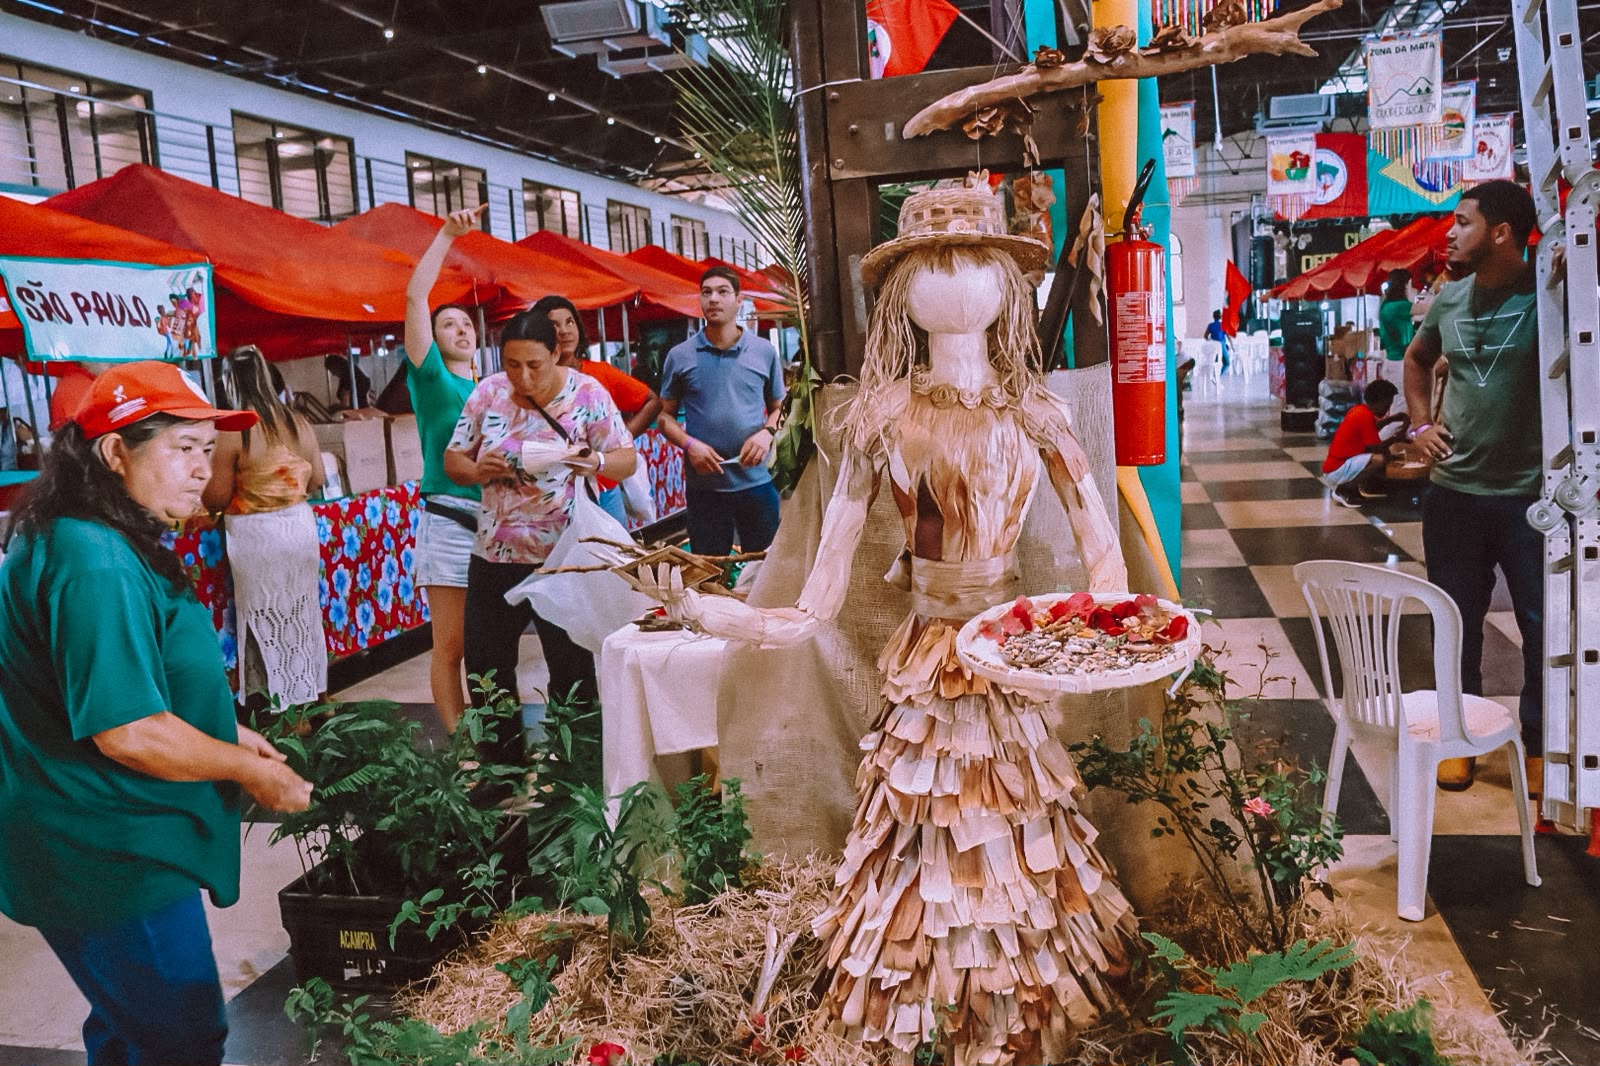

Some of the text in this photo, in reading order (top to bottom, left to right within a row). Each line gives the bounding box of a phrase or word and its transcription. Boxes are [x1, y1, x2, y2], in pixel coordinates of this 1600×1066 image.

[1370, 41, 1435, 57] ZONA DA MATA
[16, 280, 73, 325] SÃO
[70, 290, 152, 328] PAULO
[339, 930, 377, 950] ACAMPRA
